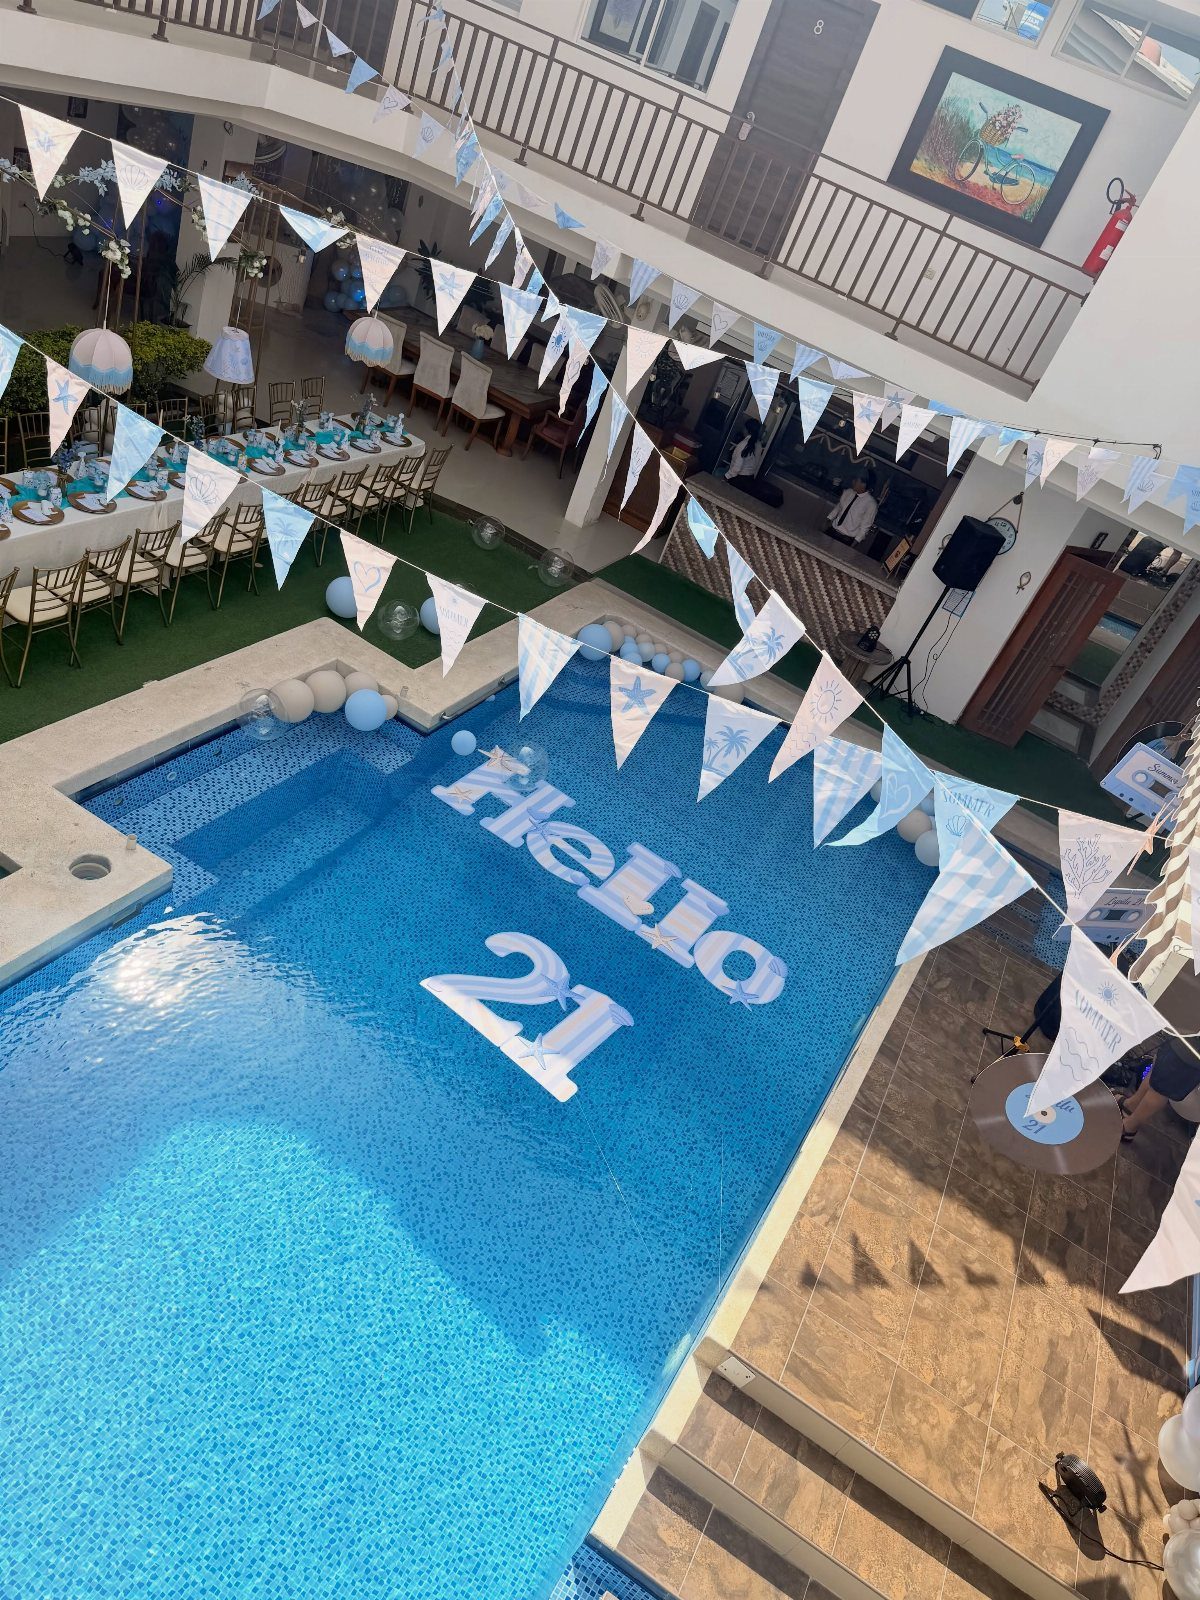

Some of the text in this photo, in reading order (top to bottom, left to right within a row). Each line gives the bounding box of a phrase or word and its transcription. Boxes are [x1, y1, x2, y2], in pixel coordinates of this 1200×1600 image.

[814, 20, 824, 34] 8
[1147, 763, 1179, 785] Summer
[430, 753, 789, 1006] Hello
[419, 931, 635, 1103] 21
[1022, 1119, 1047, 1134] 21
